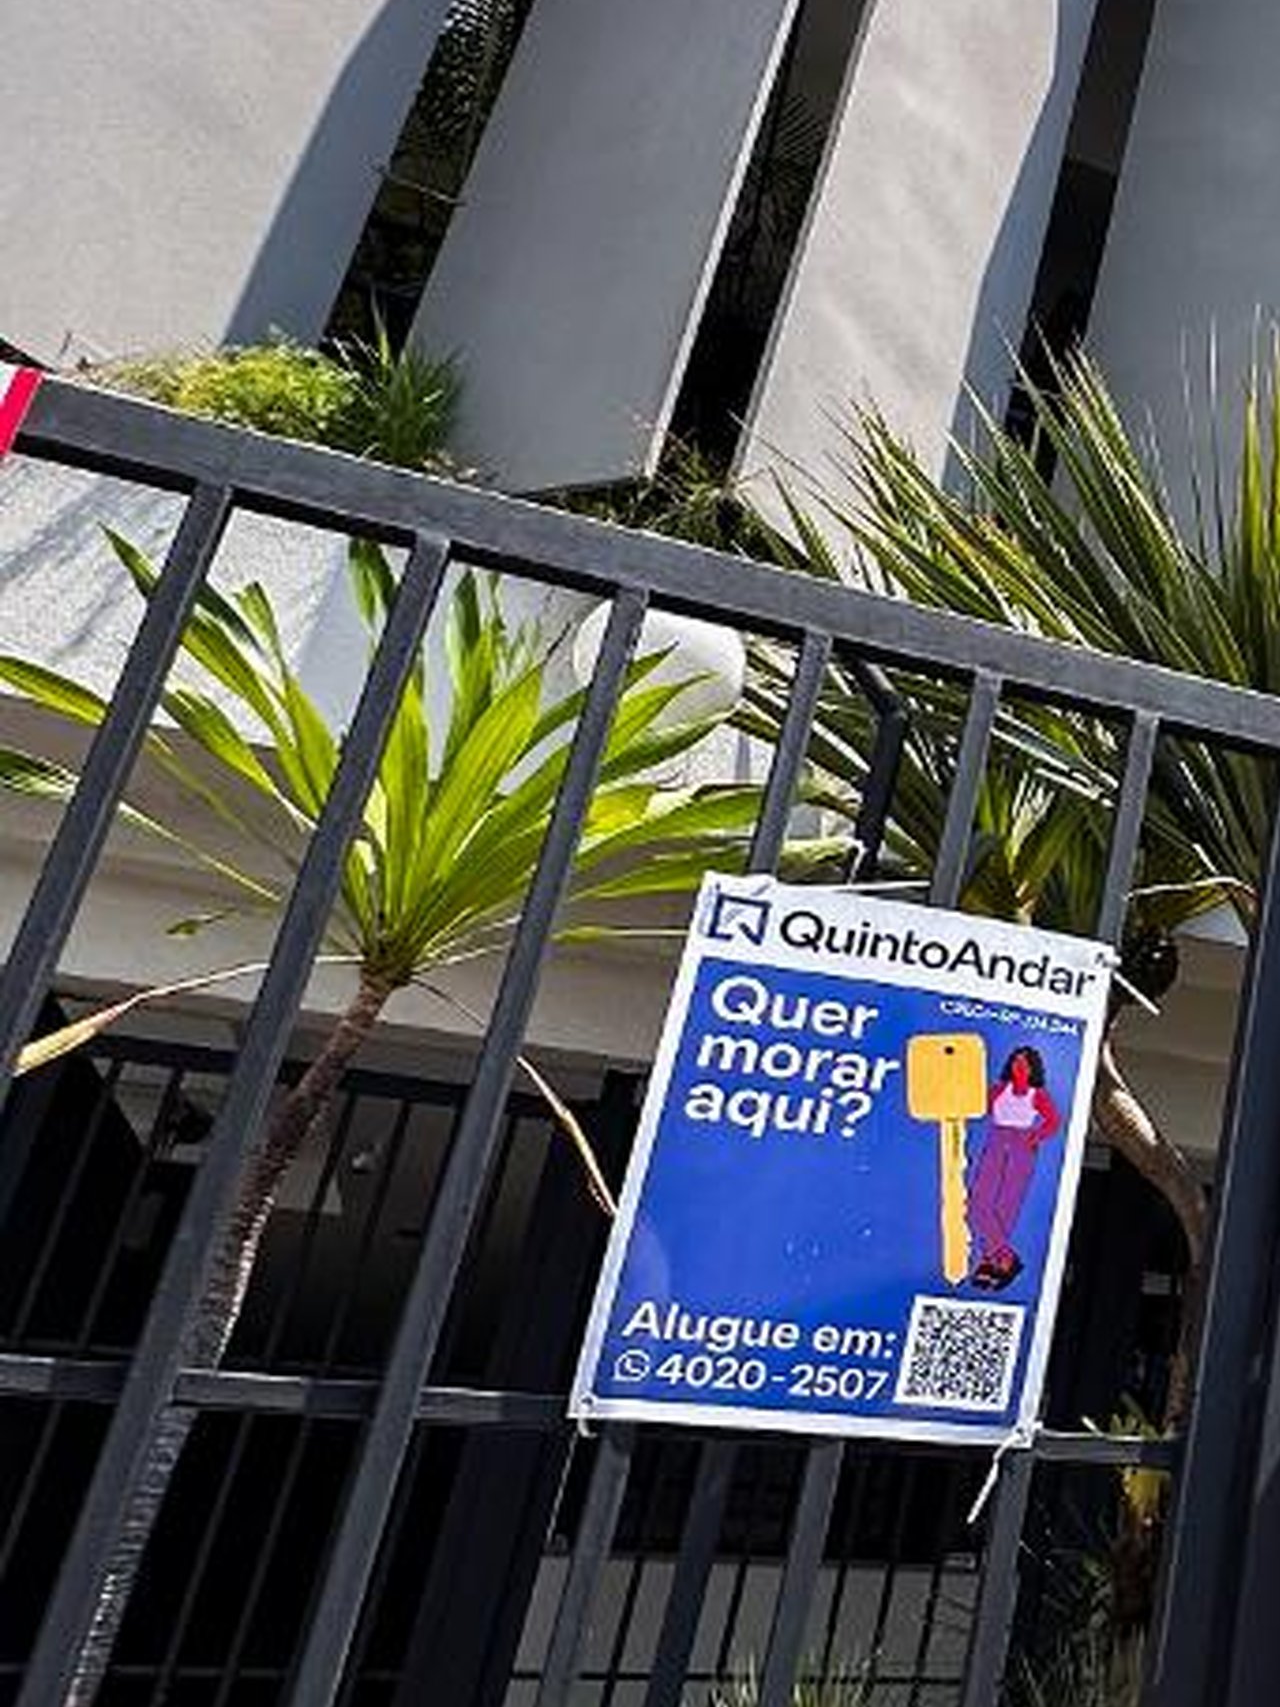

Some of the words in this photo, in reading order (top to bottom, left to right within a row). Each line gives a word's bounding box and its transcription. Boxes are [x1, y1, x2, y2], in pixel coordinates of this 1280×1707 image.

[780, 910, 1096, 997] QuintoAndar
[711, 976, 879, 1039] Quer
[696, 1033, 900, 1093] morar
[684, 1081, 873, 1138] aqui?
[621, 1301, 800, 1353] Alugue
[813, 1324, 897, 1359] em:
[655, 1354, 889, 1400] 4020-2507
